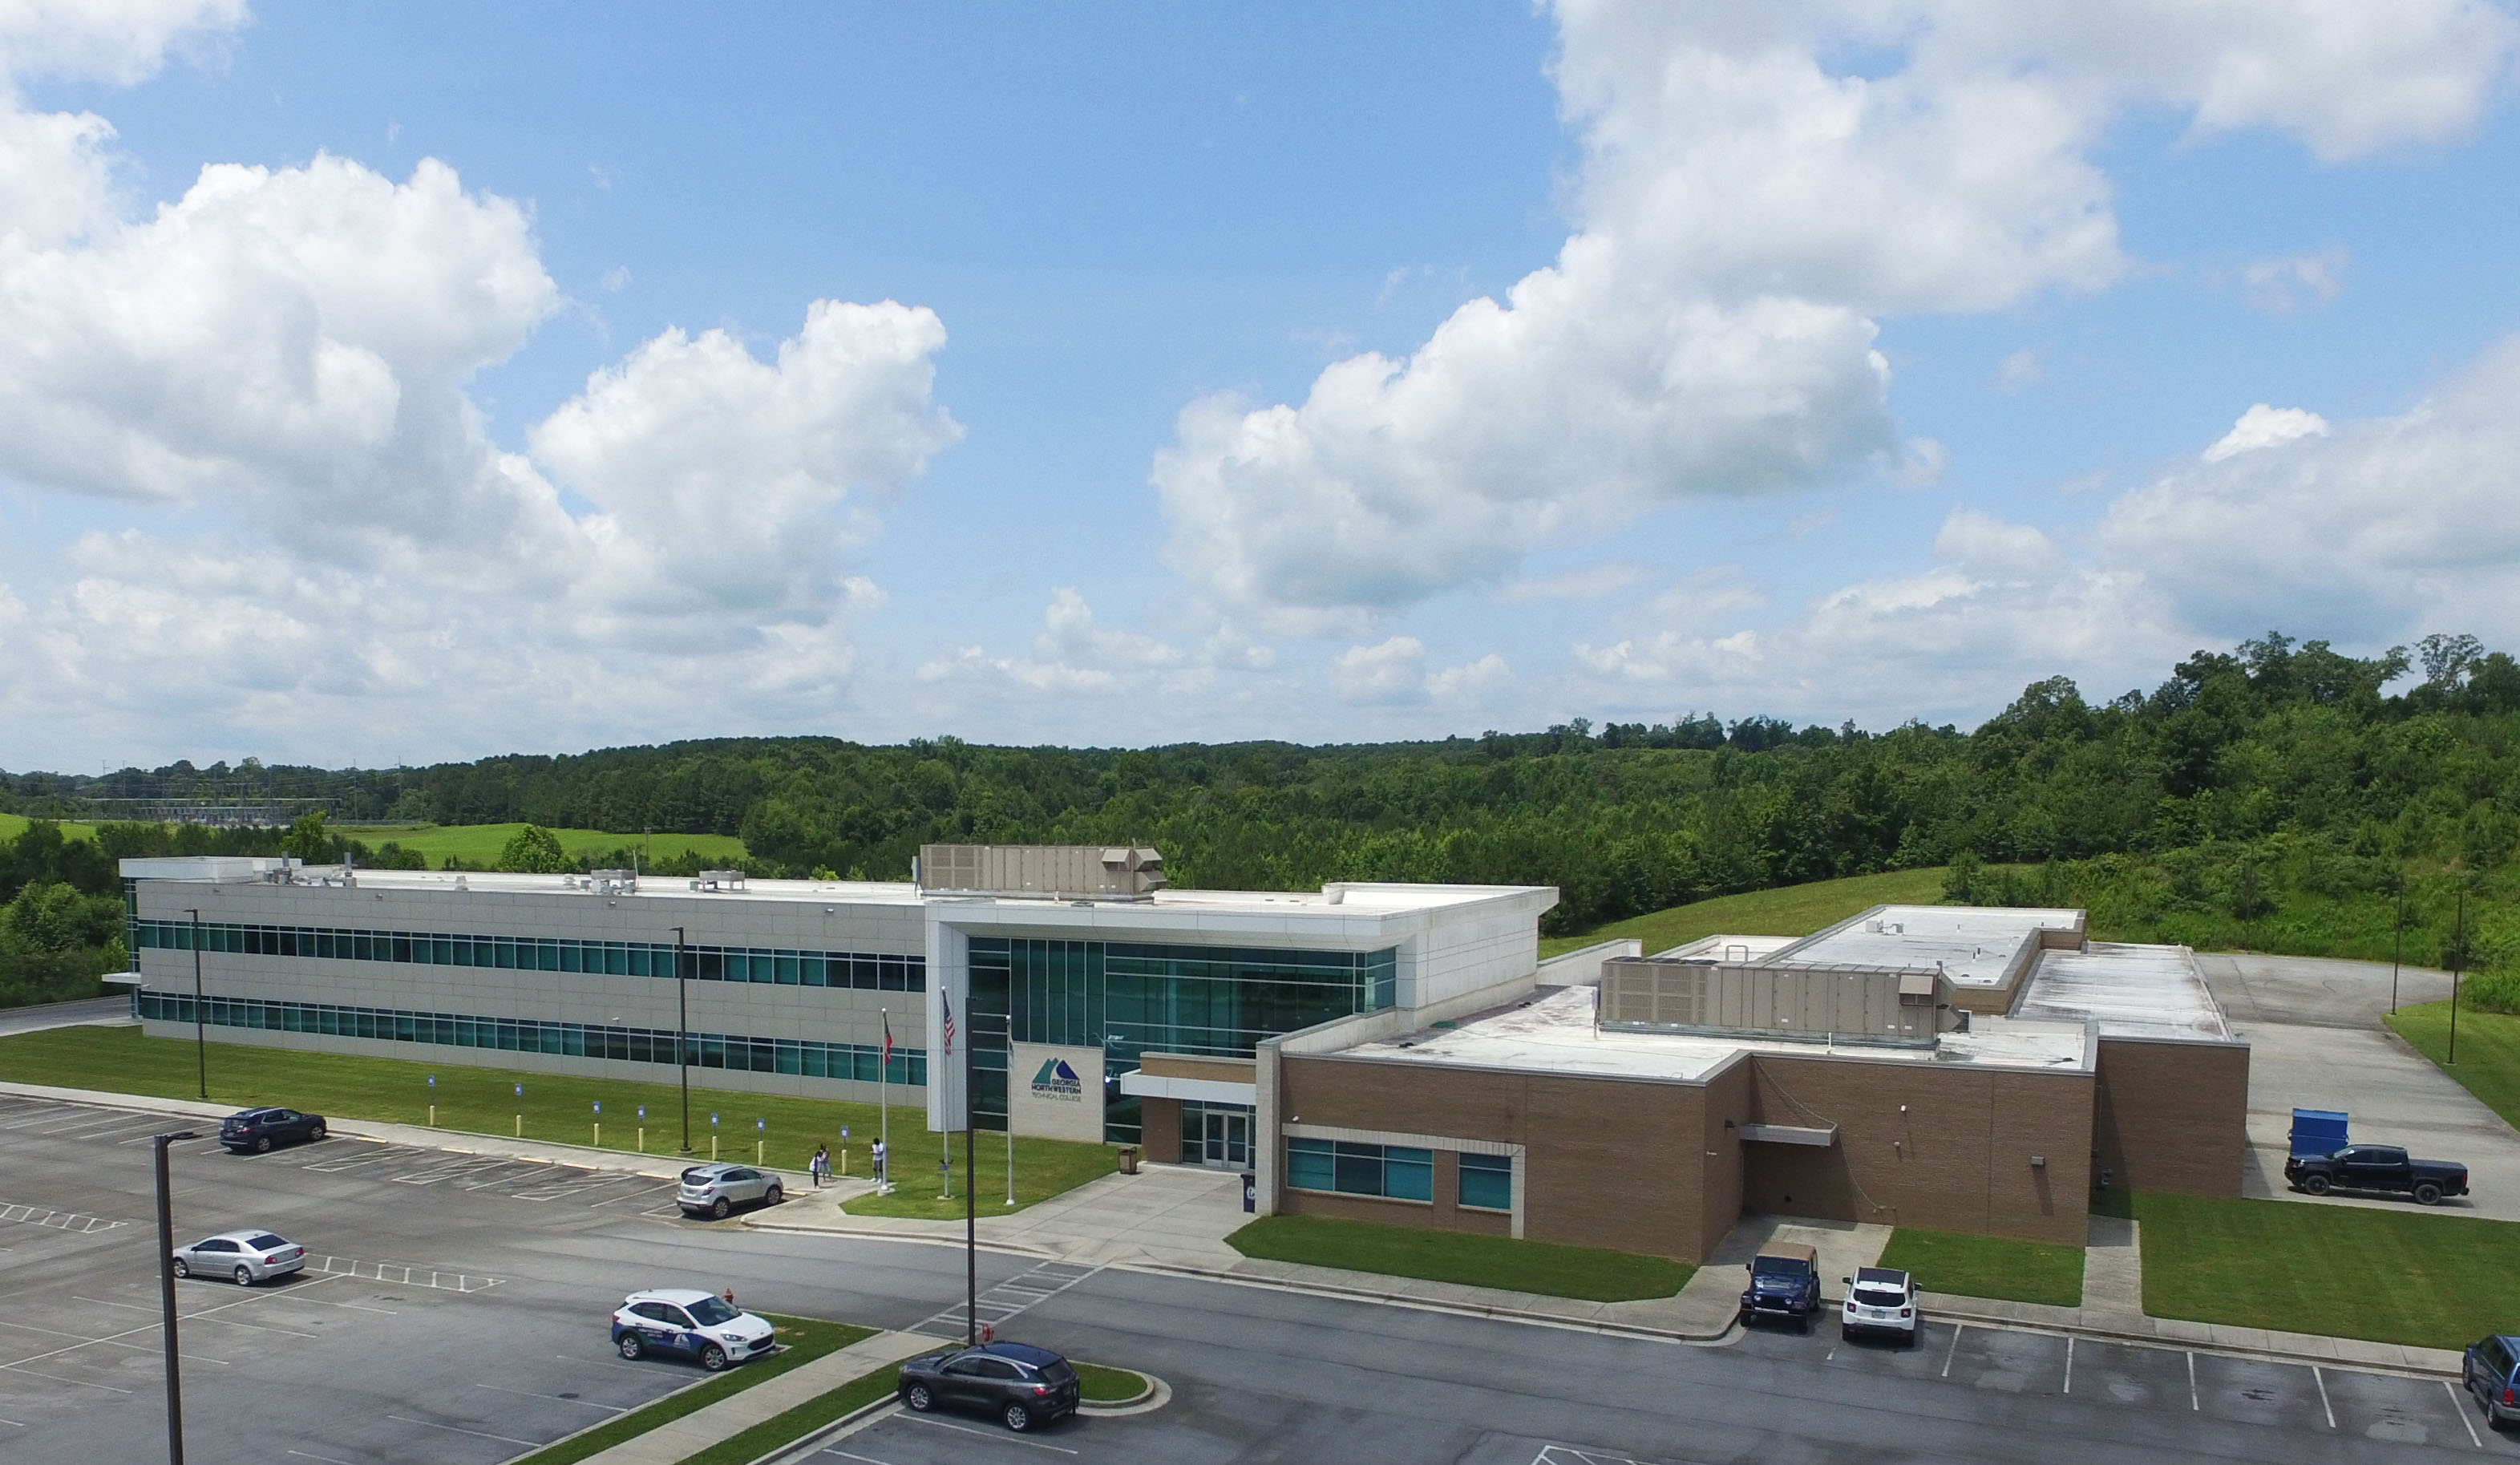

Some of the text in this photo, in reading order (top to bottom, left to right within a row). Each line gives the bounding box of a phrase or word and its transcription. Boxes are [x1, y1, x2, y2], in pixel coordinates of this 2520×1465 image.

[1051, 1079, 1081, 1087] GEORGIA
[1031, 1084, 1081, 1094] NORTHWESTERN
[1032, 1092, 1081, 1103] TECHNICAL COLLEGE
